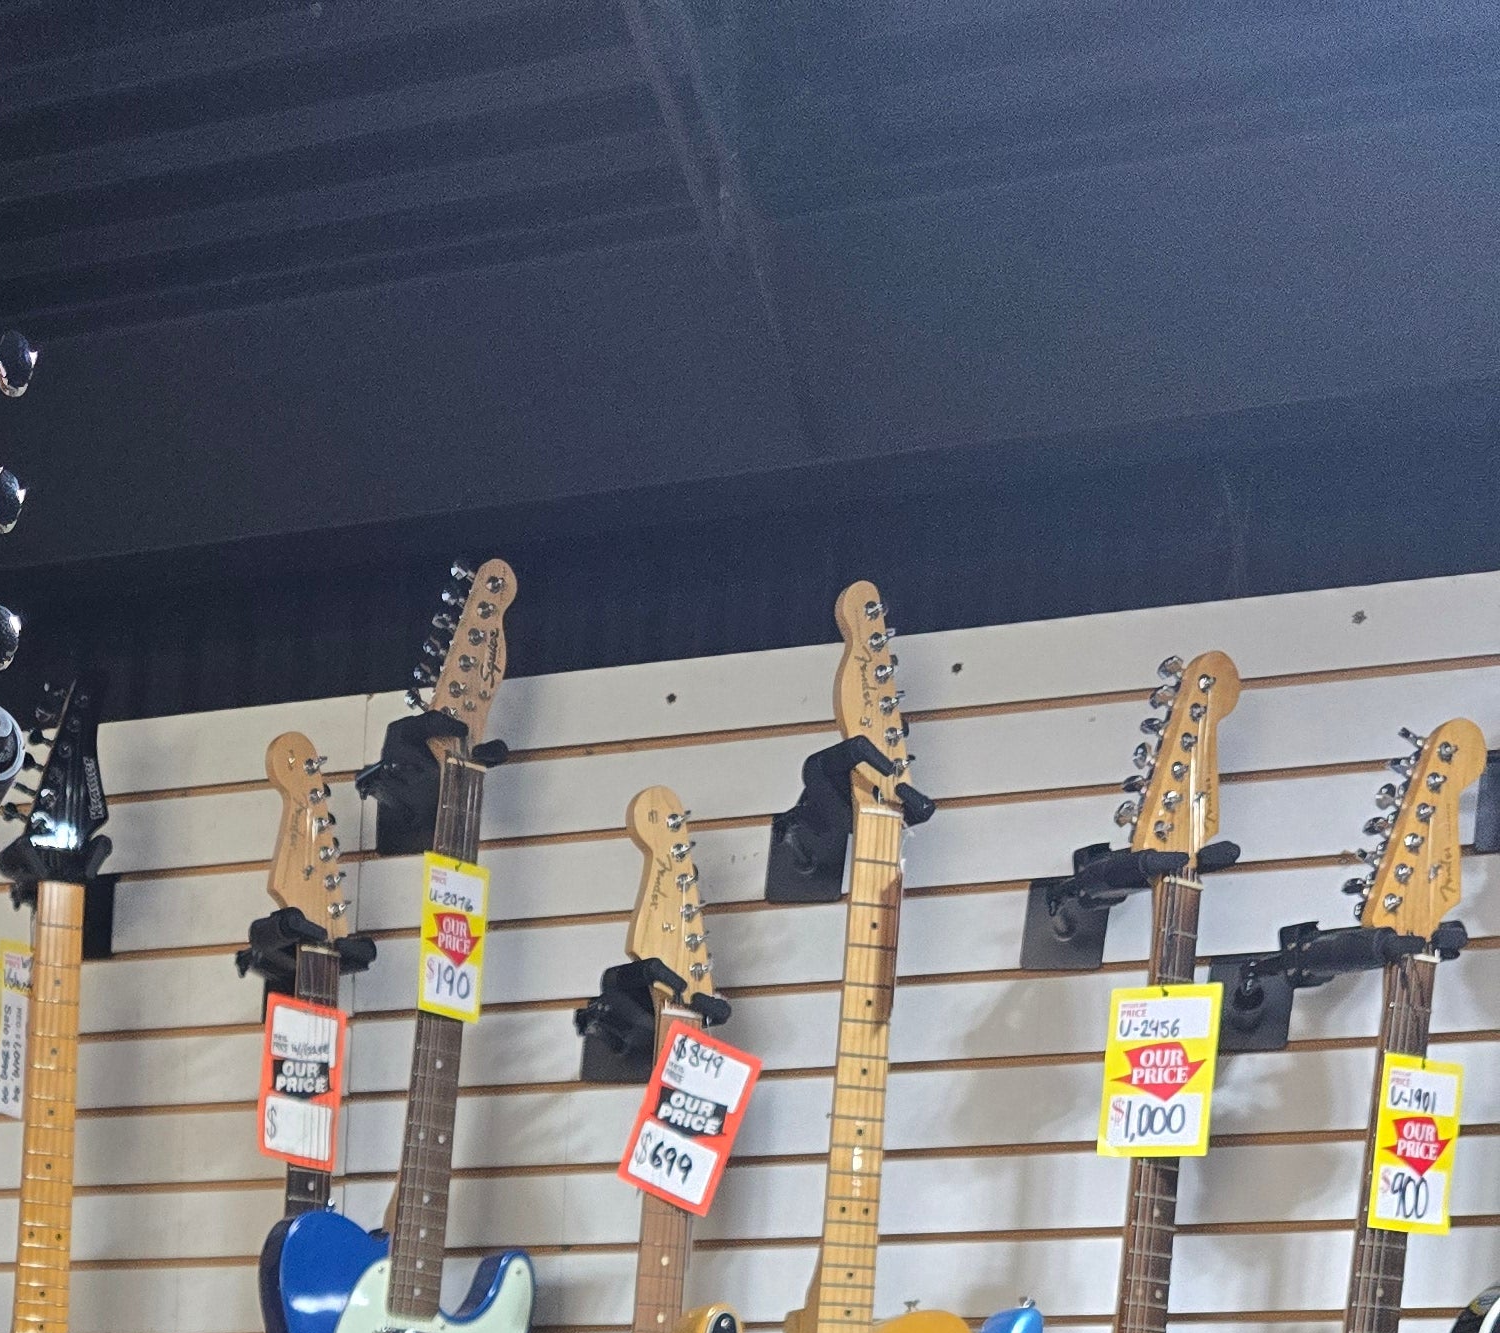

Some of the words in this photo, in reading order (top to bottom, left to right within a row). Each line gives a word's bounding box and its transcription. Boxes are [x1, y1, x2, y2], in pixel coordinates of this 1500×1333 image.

[442, 917, 467, 938] OUR
[438, 934, 471, 954] PRICE
[426, 956, 471, 999] $190
[1121, 1009, 1147, 1018] PRICE
[1119, 1018, 1181, 1038] U-2456
[1140, 1048, 1184, 1067] OUR
[282, 1060, 320, 1078] OUR
[1131, 1066, 1190, 1085] PRICE
[275, 1074, 329, 1093] PRICE
[670, 1092, 716, 1117] OUR
[1390, 1086, 1436, 1114] U-1901
[266, 1105, 277, 1141] $
[657, 1105, 723, 1135] PRICE
[1111, 1097, 1185, 1142] $1,000
[1403, 1120, 1436, 1141] OUR
[635, 1131, 693, 1185] $699
[1396, 1139, 1439, 1160] PRICE
[1380, 1168, 1430, 1218] $900
